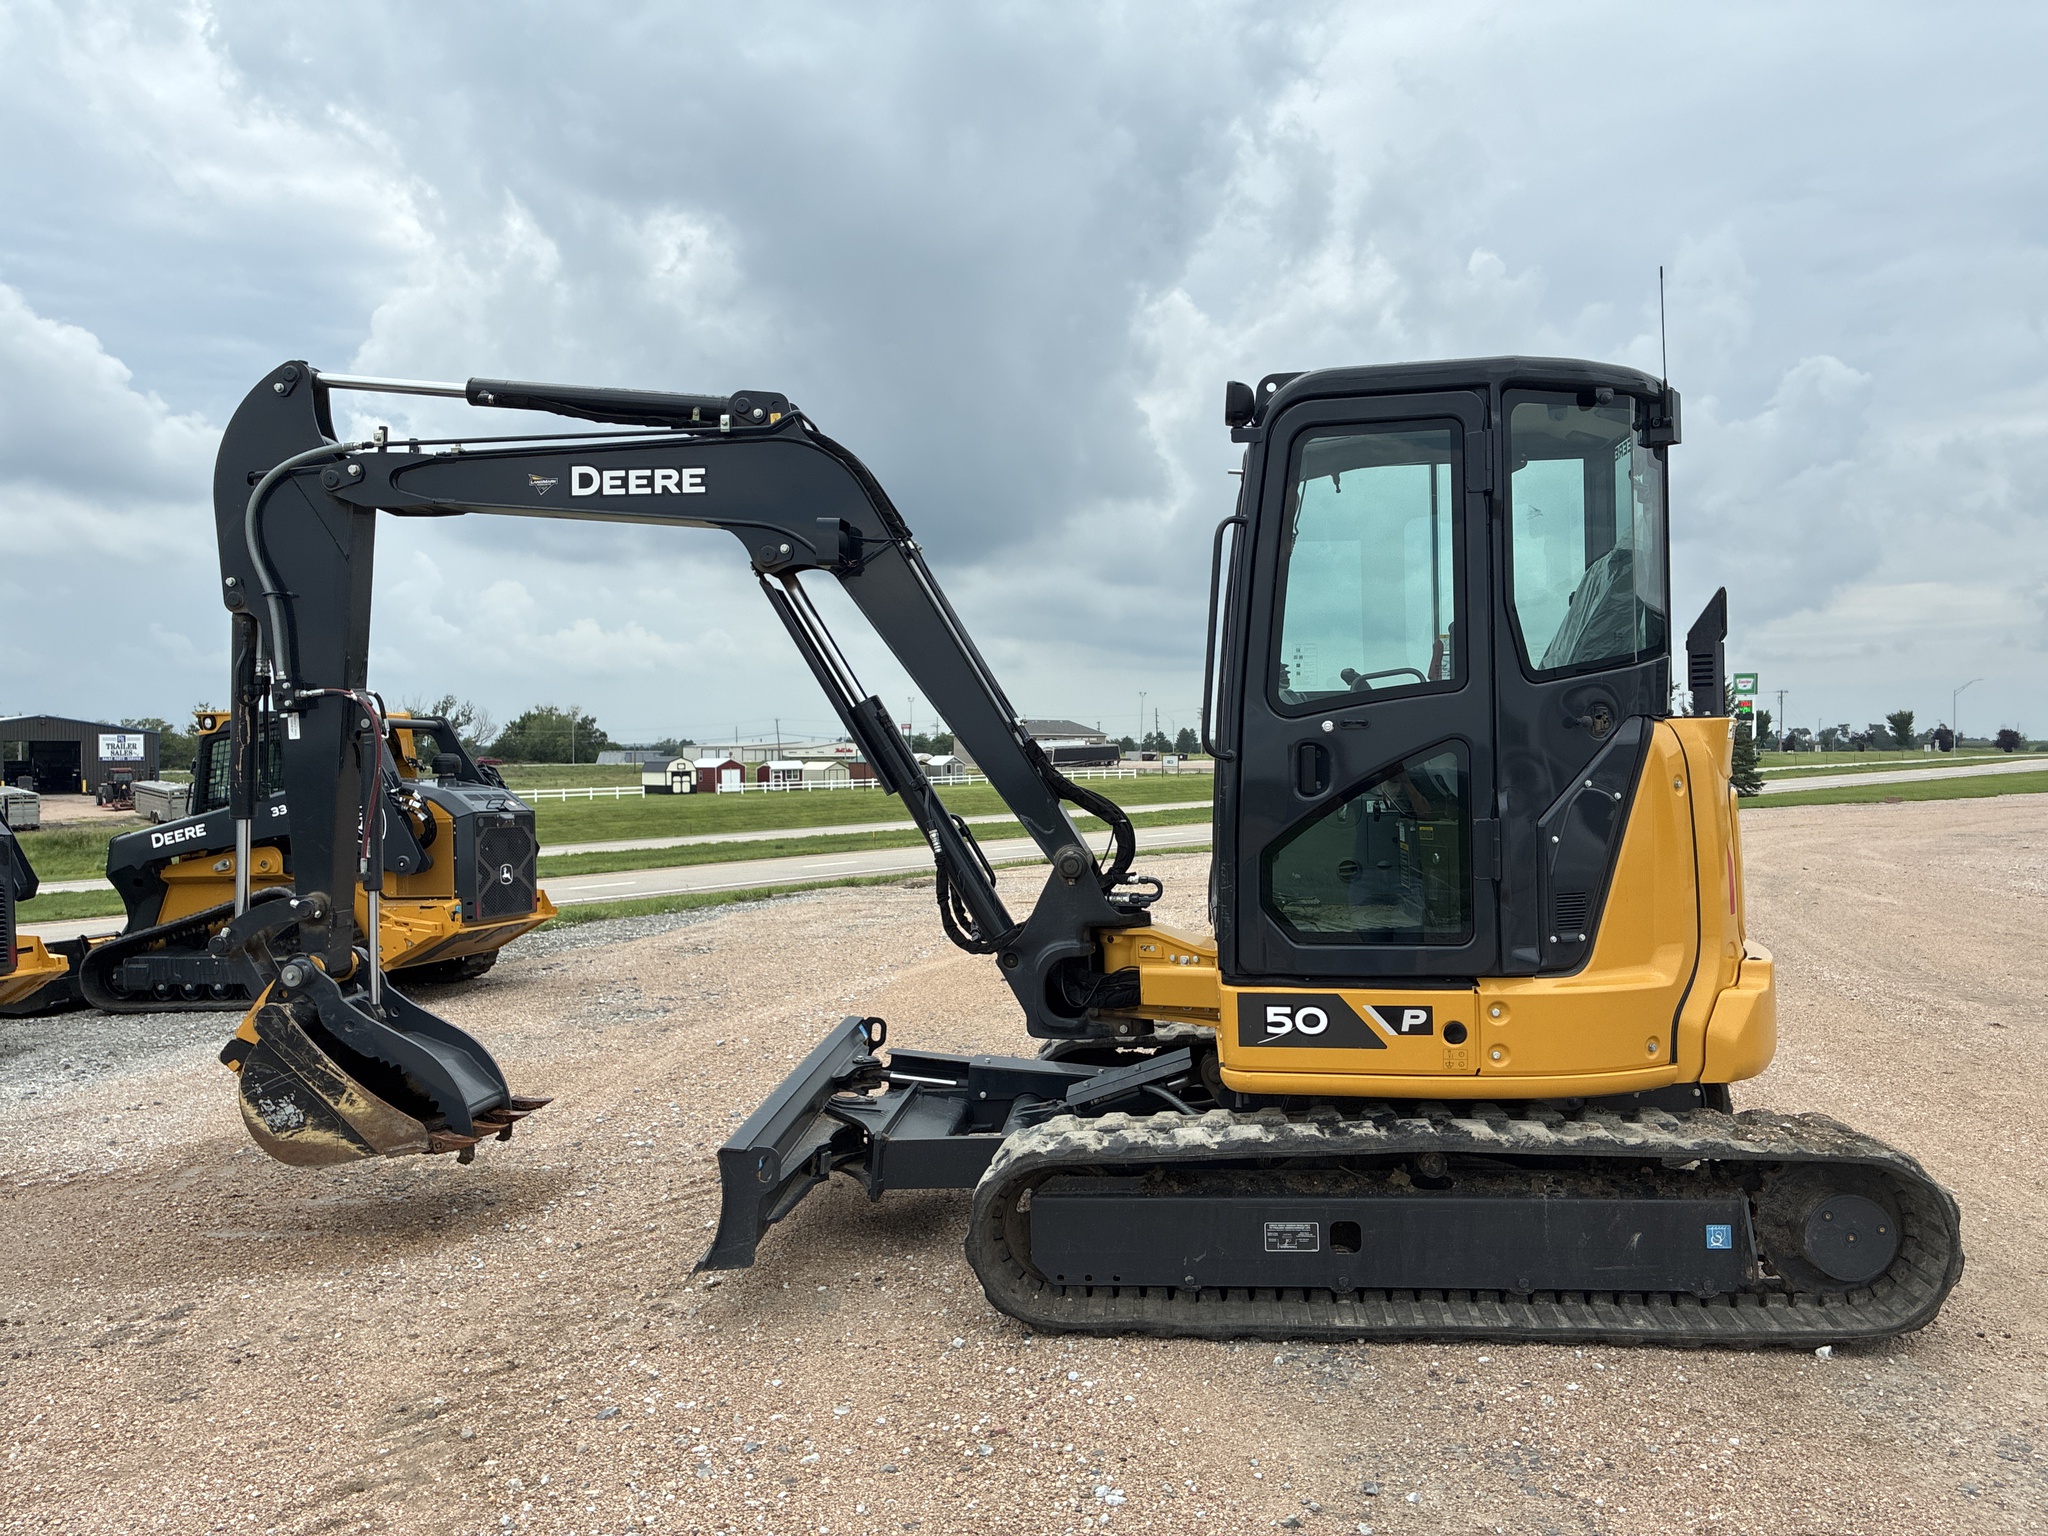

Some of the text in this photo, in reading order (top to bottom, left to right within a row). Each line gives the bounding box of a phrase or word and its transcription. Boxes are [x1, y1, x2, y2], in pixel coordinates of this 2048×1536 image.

[571, 465, 706, 496] DEERE
[270, 804, 288, 818] 33
[151, 823, 207, 849] DEERE
[1266, 1006, 1427, 1035] 50 P
